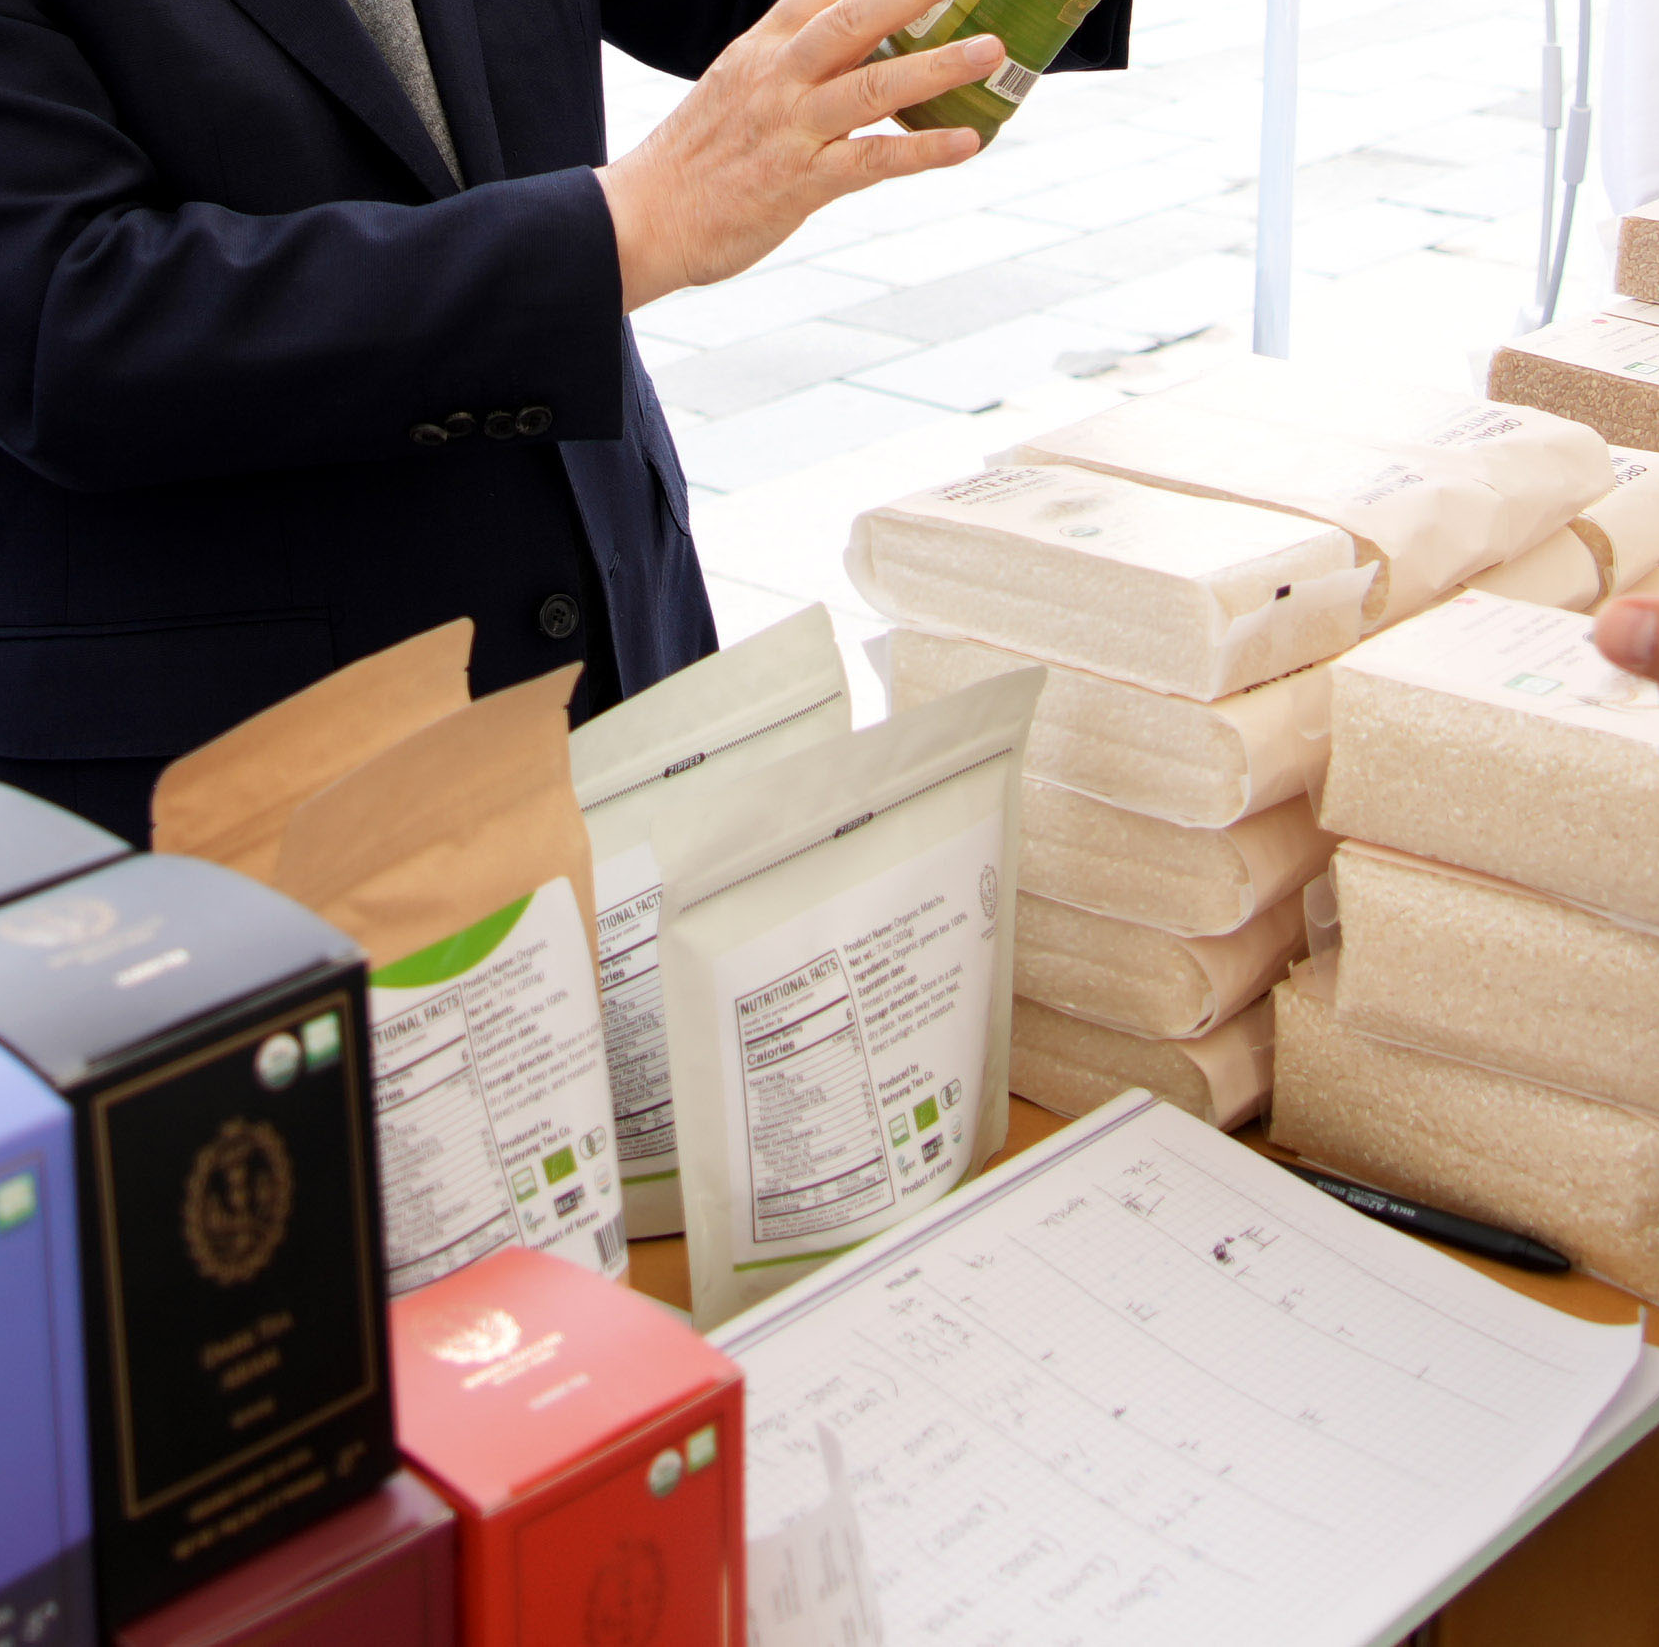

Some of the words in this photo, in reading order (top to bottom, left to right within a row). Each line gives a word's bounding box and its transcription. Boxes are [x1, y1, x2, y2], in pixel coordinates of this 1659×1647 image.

[667, 754, 702, 777] ZIPPER
[838, 814, 871, 837] ZIPPER
[636, 890, 662, 912] FACTS
[843, 933, 872, 954] Product
[872, 924, 894, 940] Name:
[894, 909, 920, 928] Organic
[920, 895, 945, 912] Matcha
[892, 942, 919, 961] Organic
[920, 931, 939, 947] green
[950, 911, 968, 927] 100%
[463, 968, 492, 991] Product
[516, 938, 549, 961] Organic
[849, 956, 862, 968] Net
[600, 968, 625, 986] ories
[740, 974, 810, 1016] NUTRITIONAL
[810, 957, 838, 981] FACTS
[858, 974, 893, 998] Expiration
[546, 989, 569, 1007] 100%
[864, 1006, 889, 1027] Storage
[889, 990, 919, 1010] direction:
[920, 978, 937, 995] Store
[373, 1014, 422, 1046] TIONAL
[423, 992, 461, 1022] FACTS
[477, 1032, 518, 1061] Expiration
[747, 1040, 795, 1066] Calories
[847, 1008, 853, 1020] 6
[878, 1067, 910, 1090] Produced
[910, 1063, 919, 1074] by
[881, 1085, 912, 1107] Bohyang
[912, 1076, 924, 1089] Tea
[500, 1125, 538, 1152] Produced
[901, 1172, 928, 1195] Product
